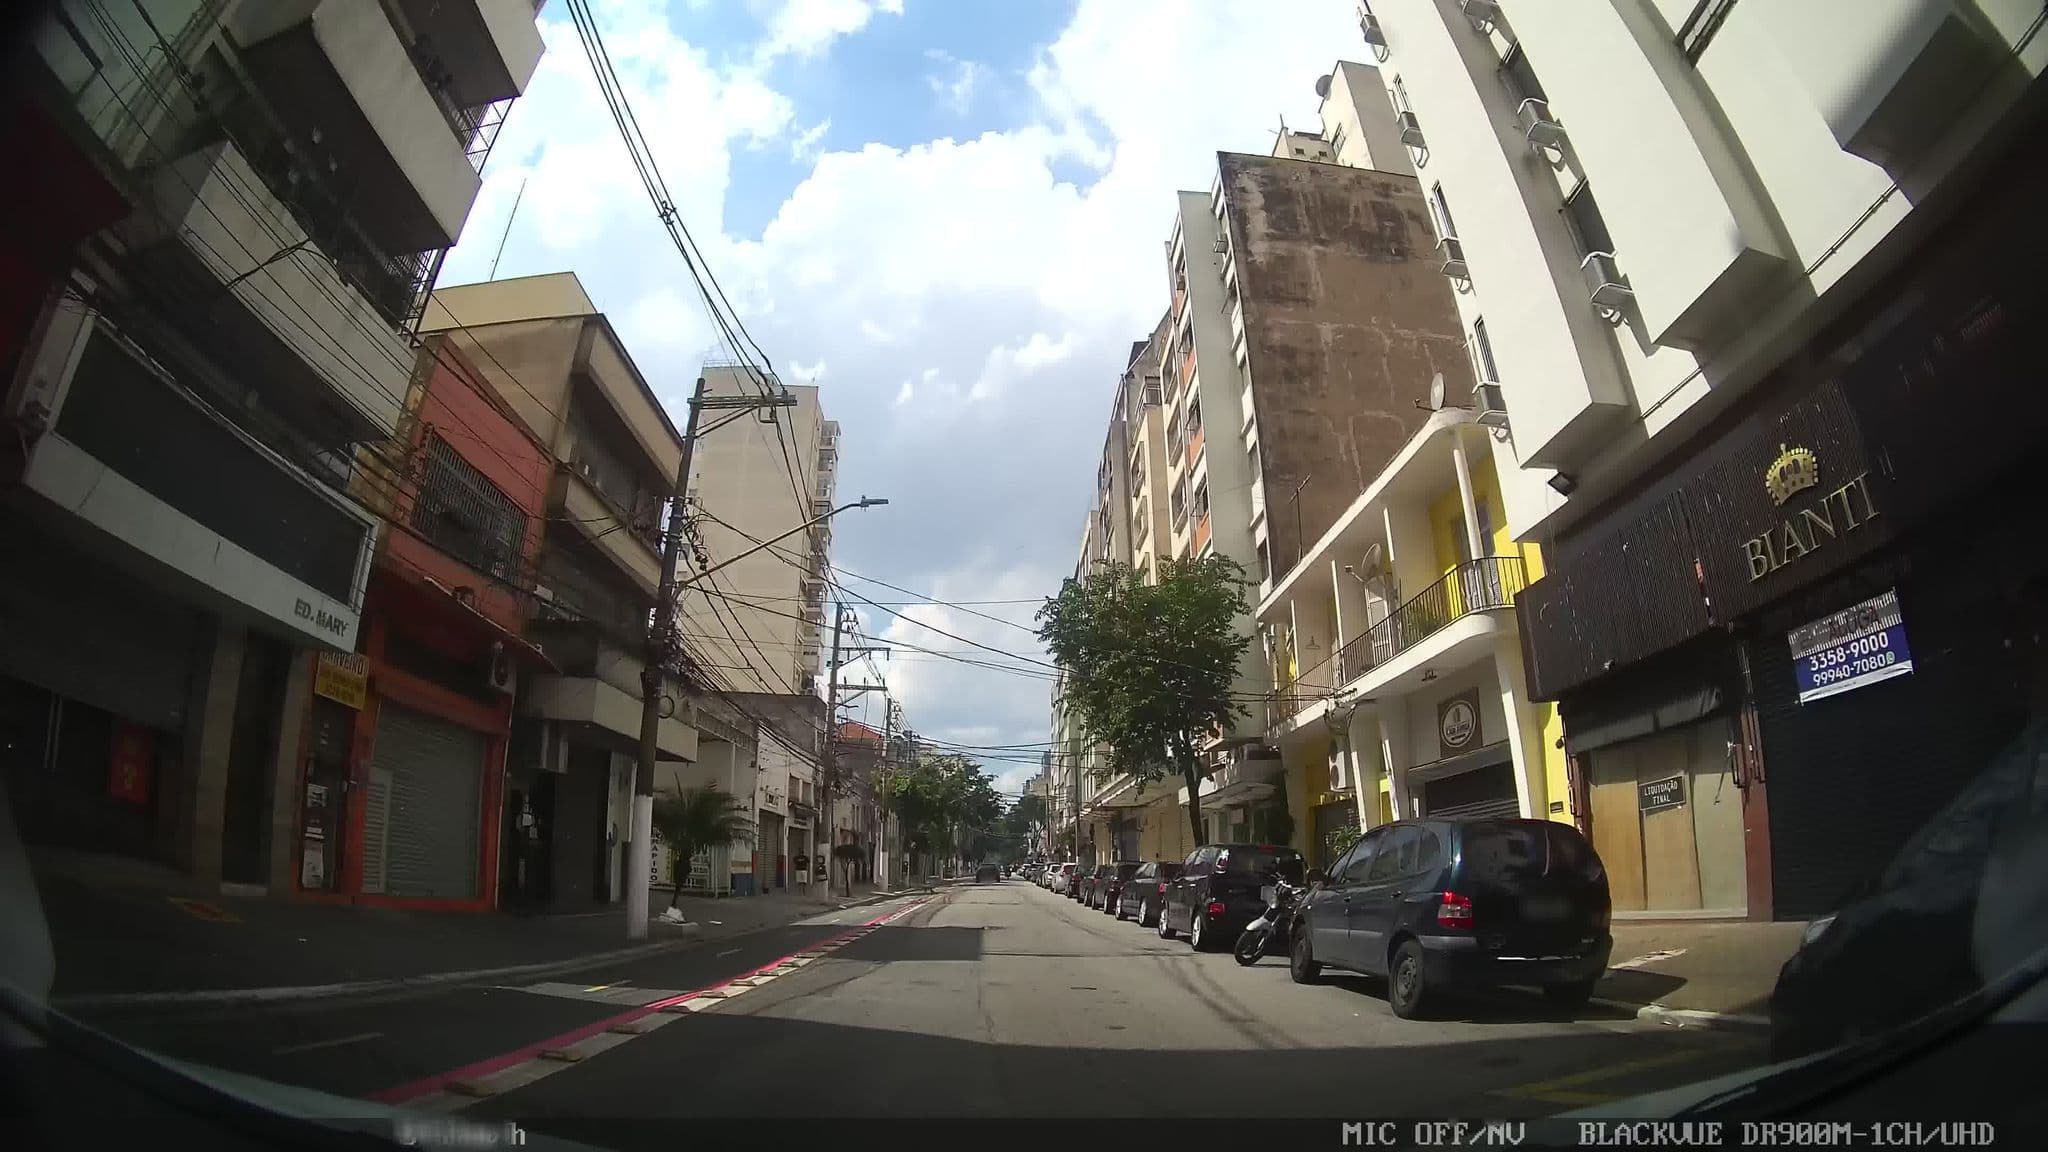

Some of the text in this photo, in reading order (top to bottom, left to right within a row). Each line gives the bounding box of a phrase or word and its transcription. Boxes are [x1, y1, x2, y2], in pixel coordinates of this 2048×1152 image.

[1741, 472, 1880, 582] BIANTI
[316, 610, 349, 637] MARY
[1809, 632, 1889, 672] 3358-9000
[1813, 654, 1886, 687] 99940-7080
[1644, 780, 1678, 796] LIQUIDAÇÃO
[1652, 794, 1671, 805] FINAL
